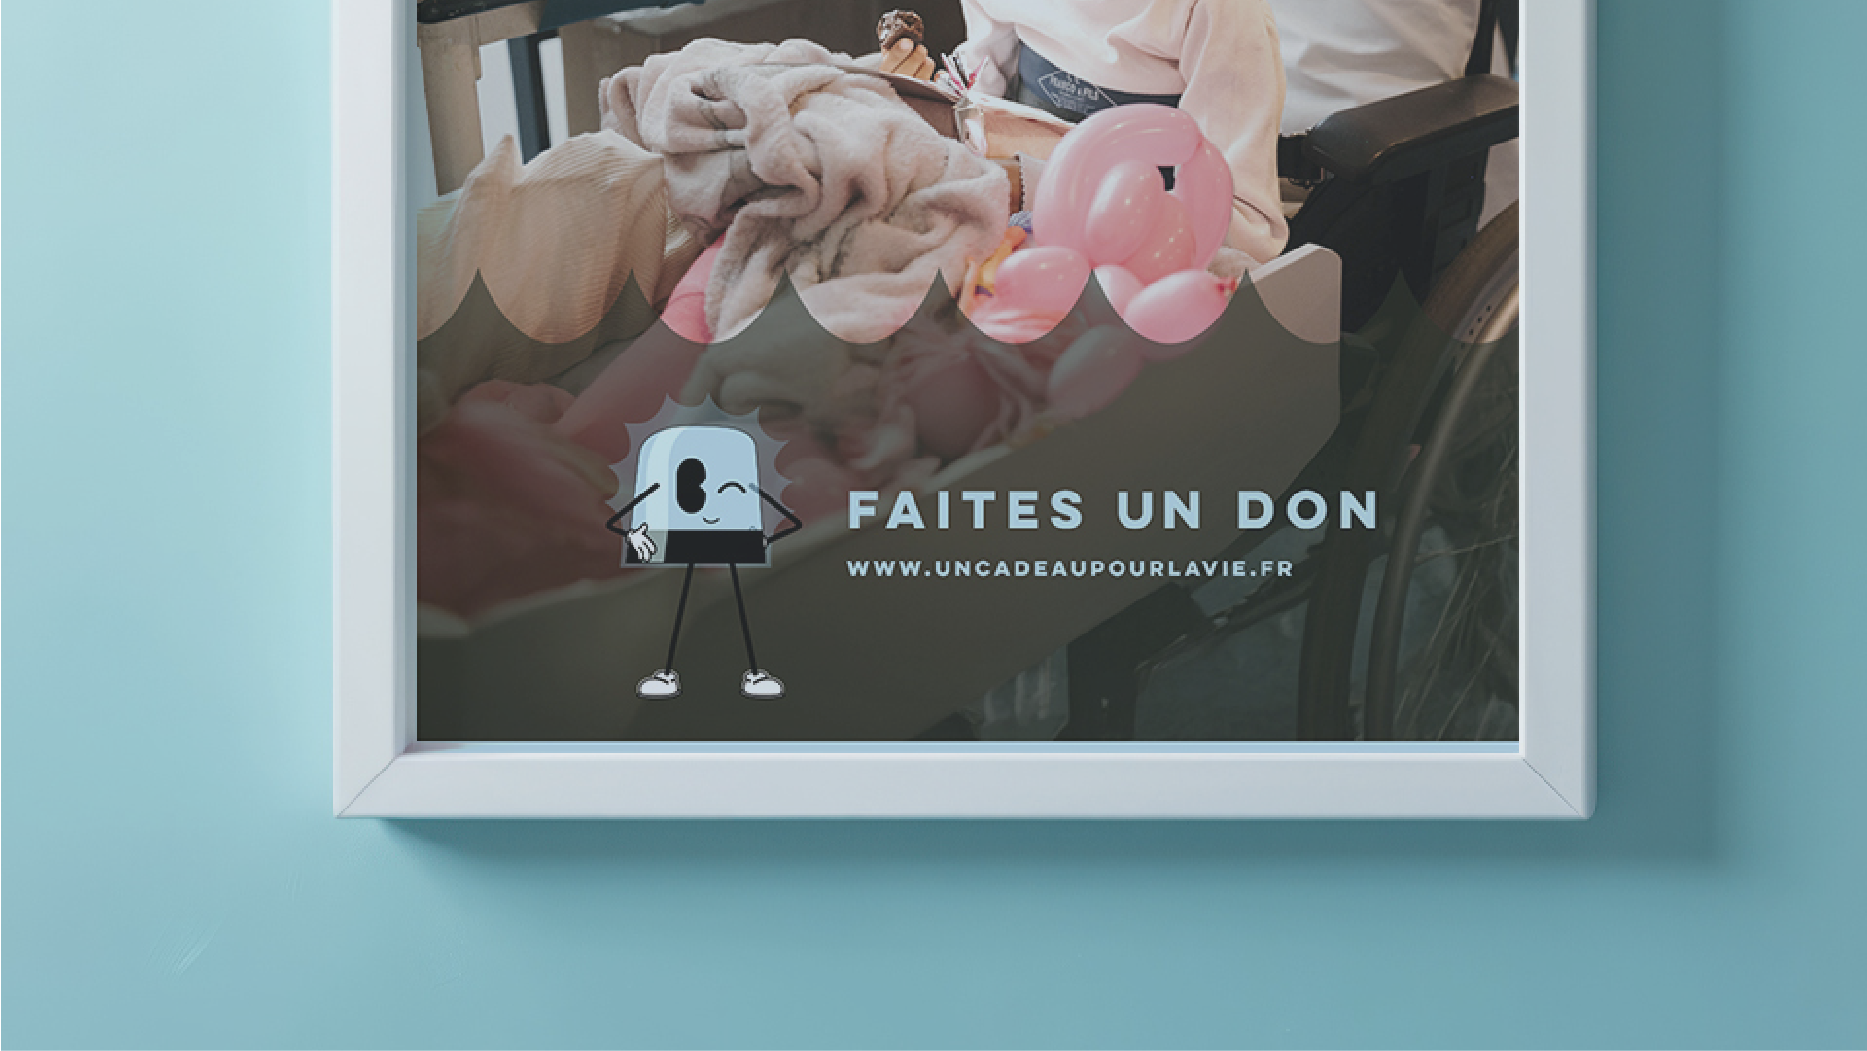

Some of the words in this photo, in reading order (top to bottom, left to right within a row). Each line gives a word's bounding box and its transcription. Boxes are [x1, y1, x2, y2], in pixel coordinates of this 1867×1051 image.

[848, 489, 1083, 530] FAITES
[1117, 489, 1200, 530] UN
[1237, 489, 1377, 530] DON
[846, 560, 1294, 578] WWW.UNCADEAUPOURLAVIE.FR
